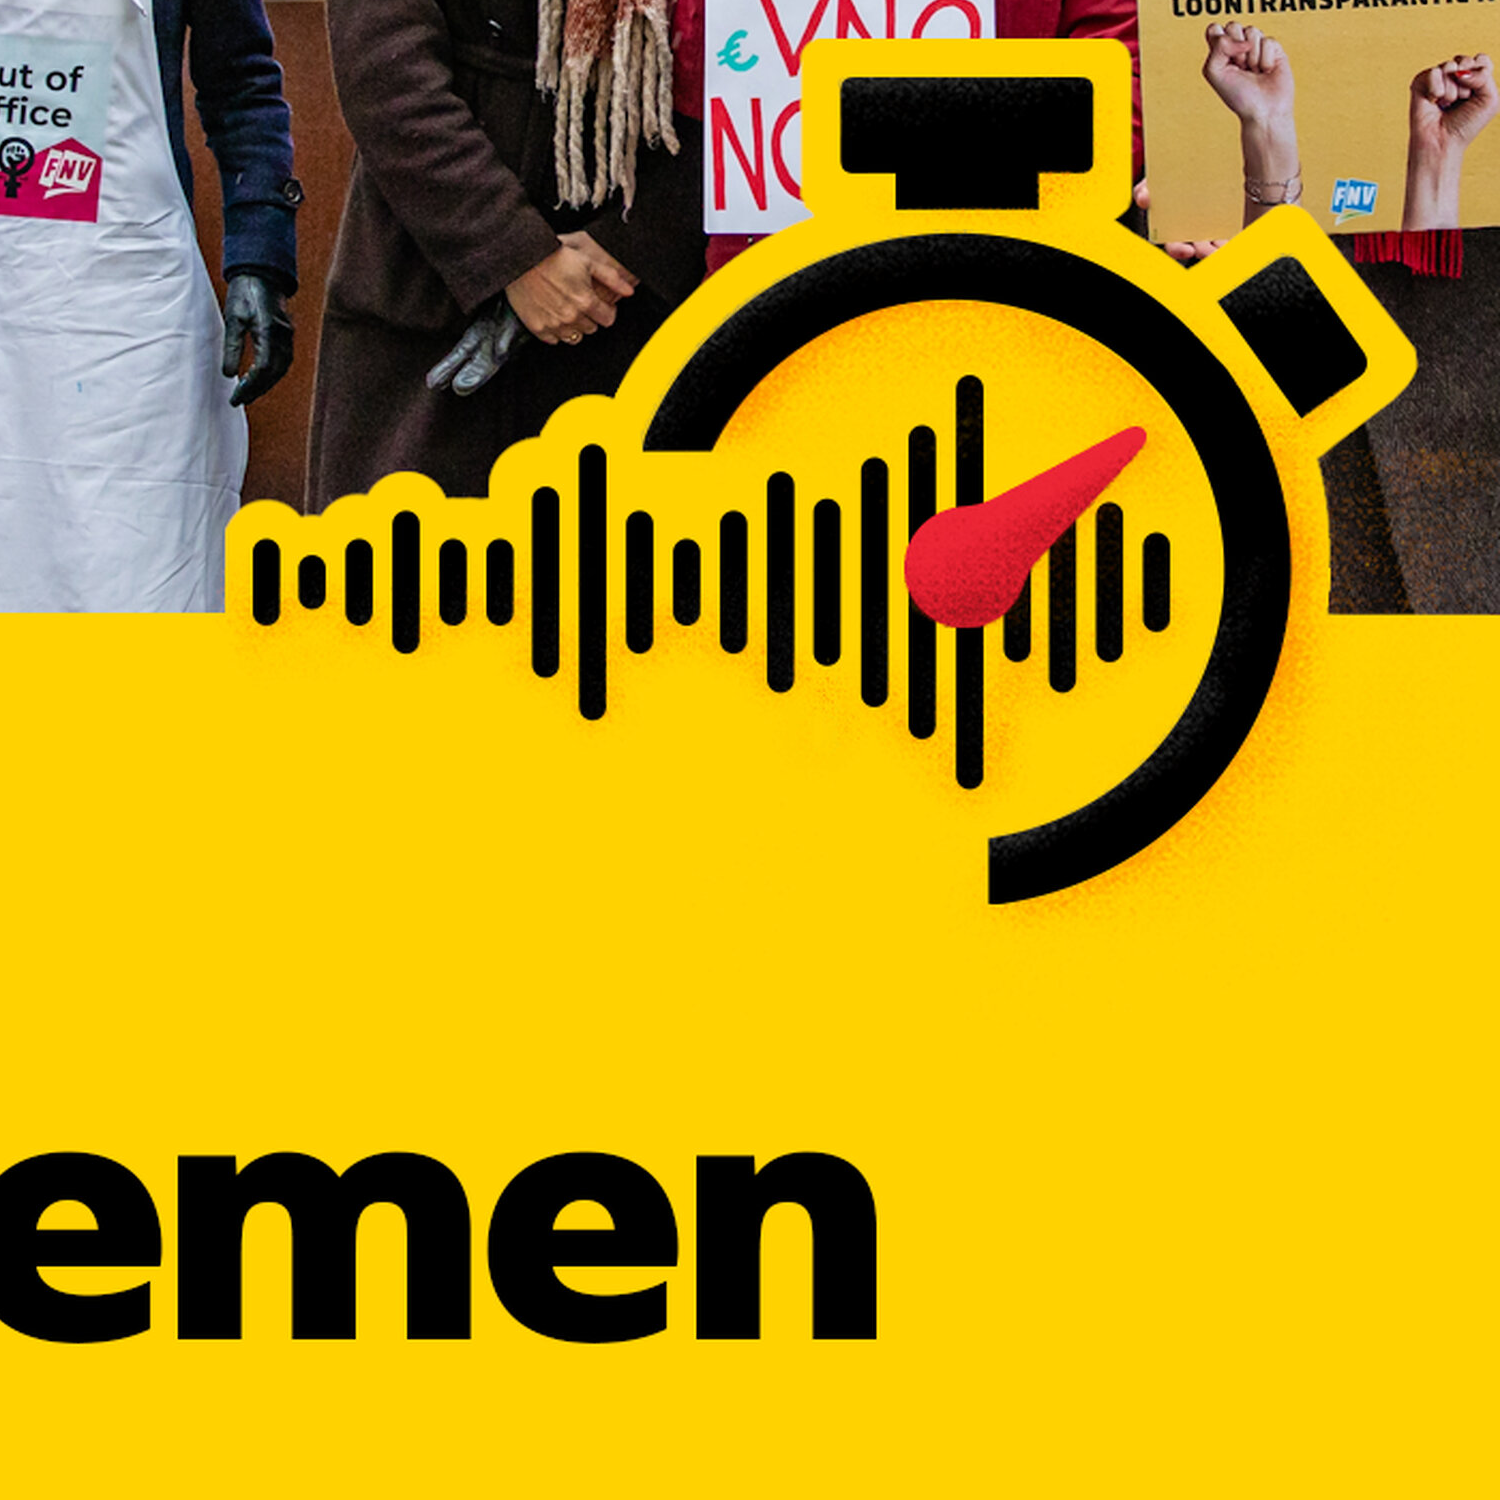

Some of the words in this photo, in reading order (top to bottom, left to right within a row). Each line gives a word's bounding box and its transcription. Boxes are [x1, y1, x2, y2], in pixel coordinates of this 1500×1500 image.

[45, 65, 85, 93] of
[44, 156, 95, 183] FNV
[1333, 184, 1377, 208] FNV
